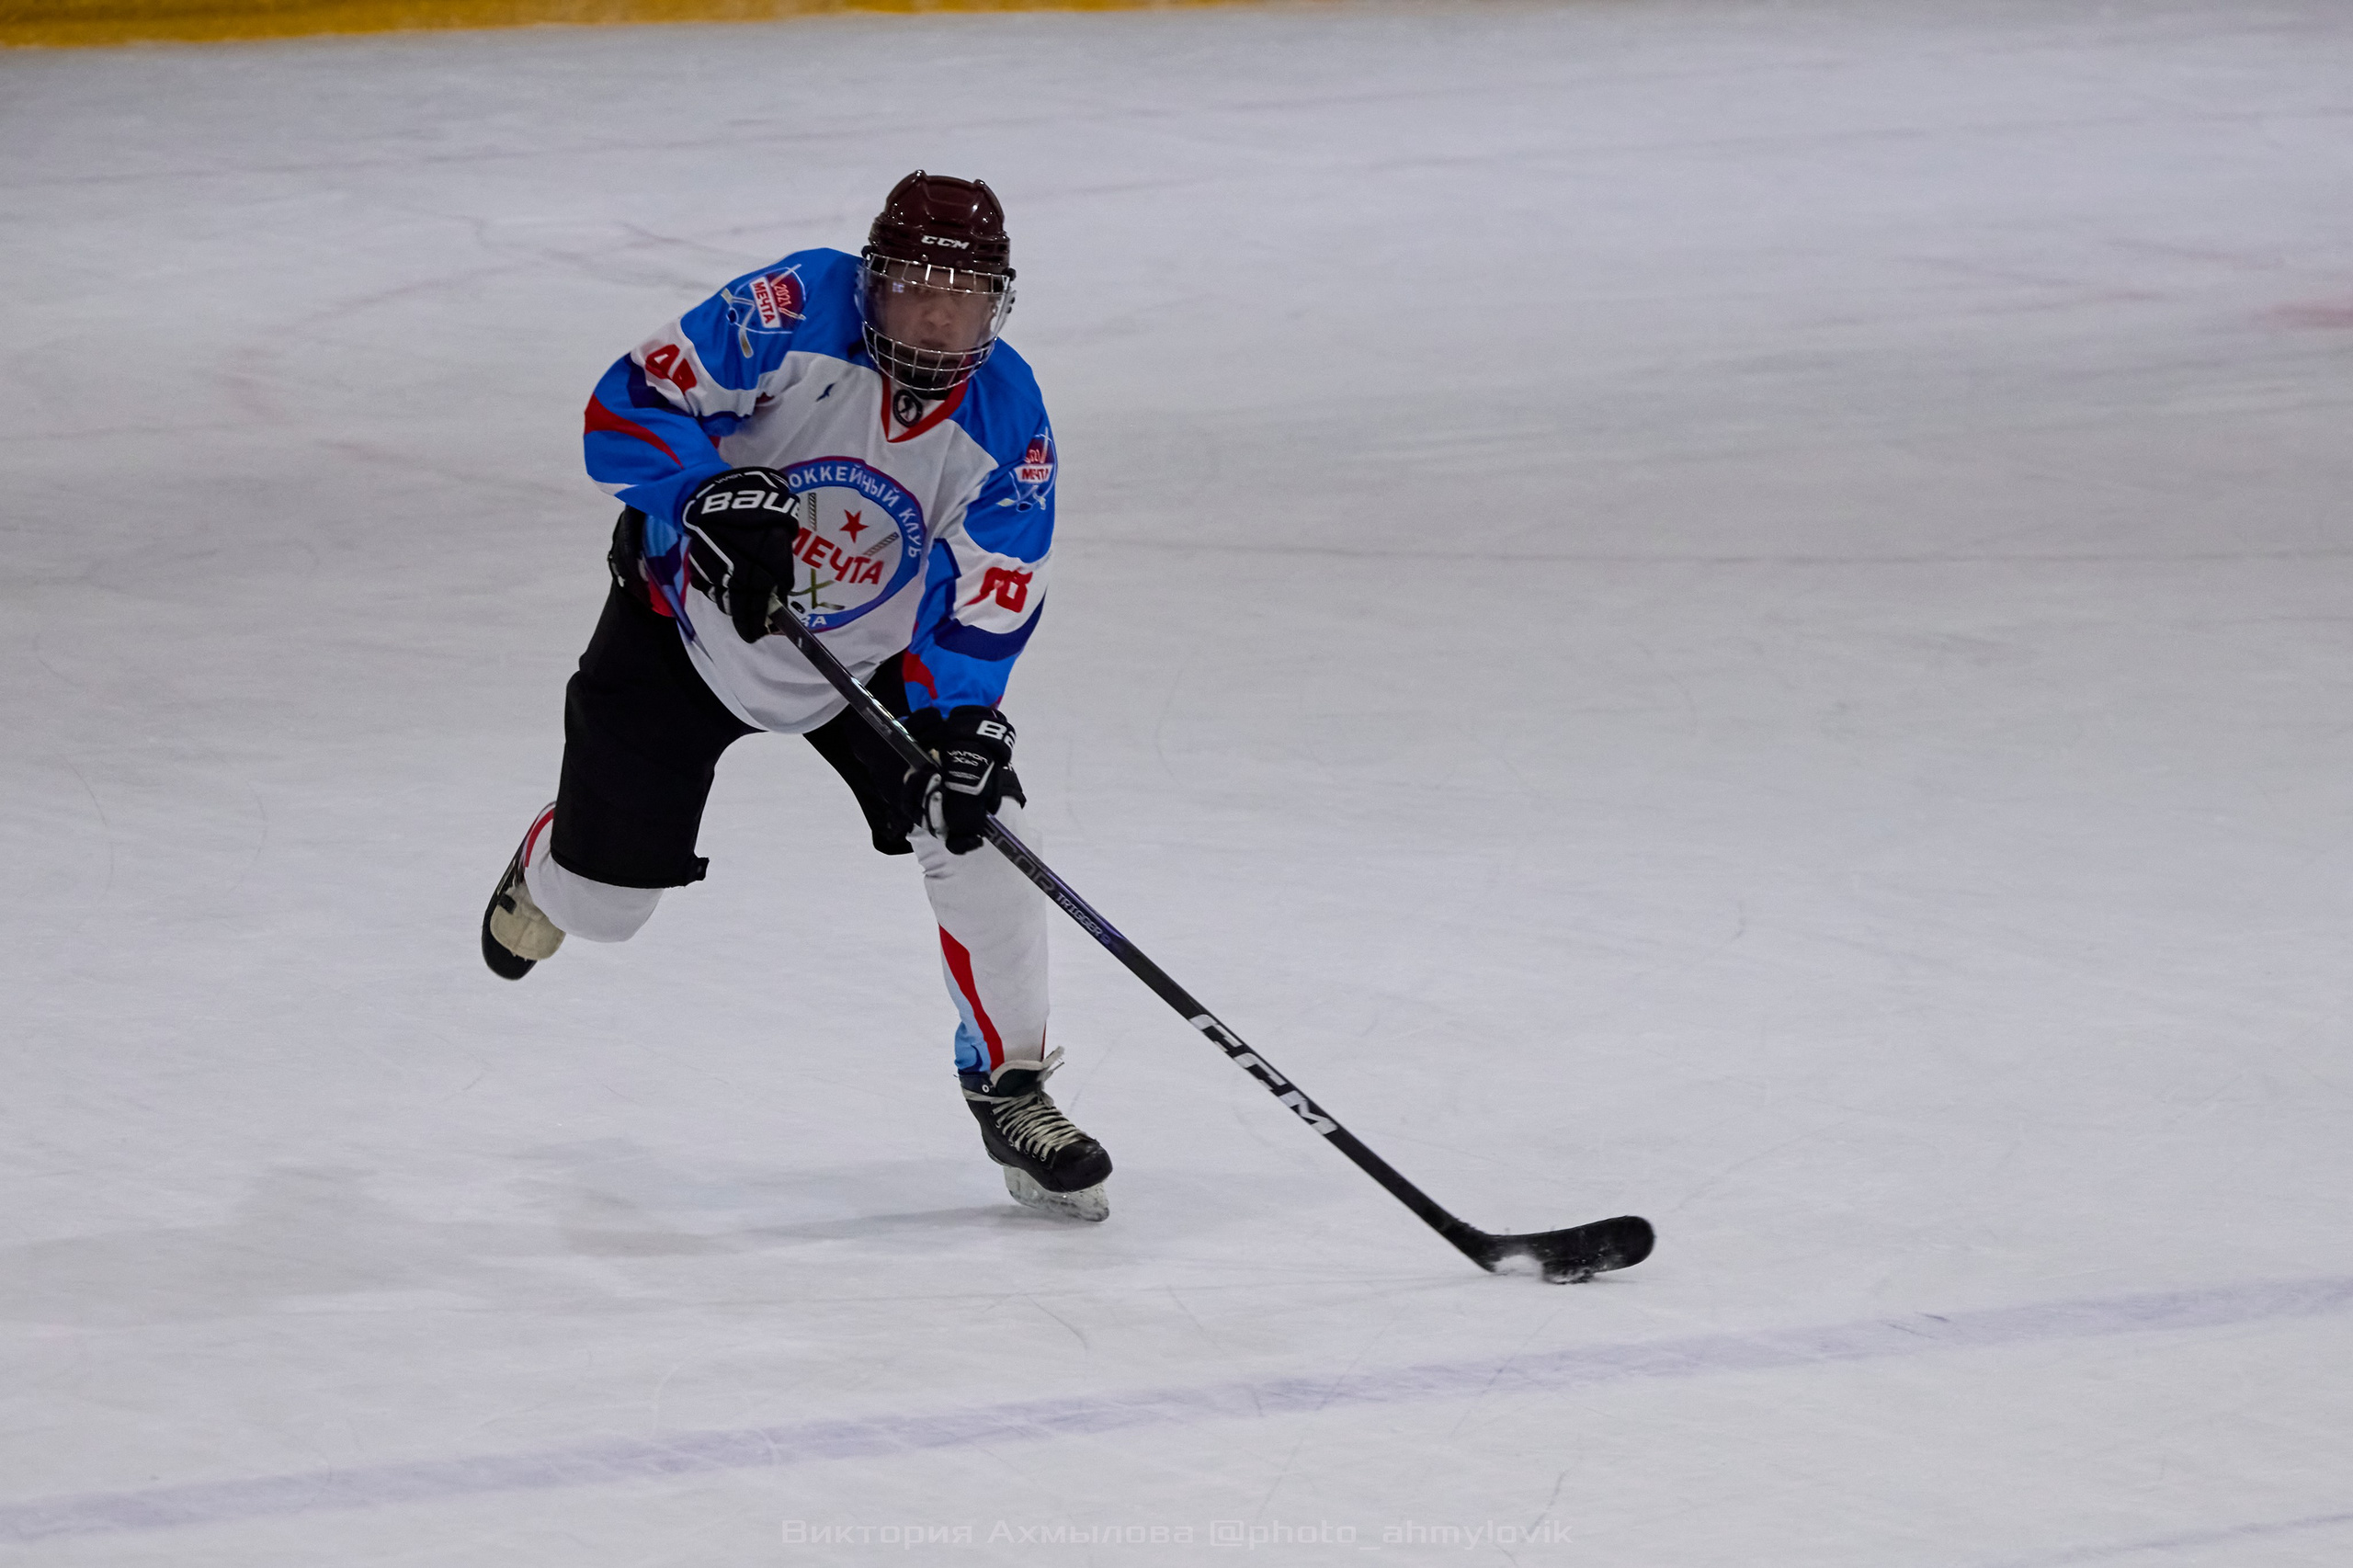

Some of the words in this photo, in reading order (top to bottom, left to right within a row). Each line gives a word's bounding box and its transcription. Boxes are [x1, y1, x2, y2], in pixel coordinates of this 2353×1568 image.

[921, 235, 970, 249] CCM
[754, 281, 776, 324] МЕЧТА
[774, 283, 791, 307] 2021
[701, 490, 800, 520] BAU
[789, 464, 901, 507] ОККЕЙНЫЙ
[1057, 892, 1103, 937] TRIGGER
[1188, 1014, 1338, 1135] CCM
